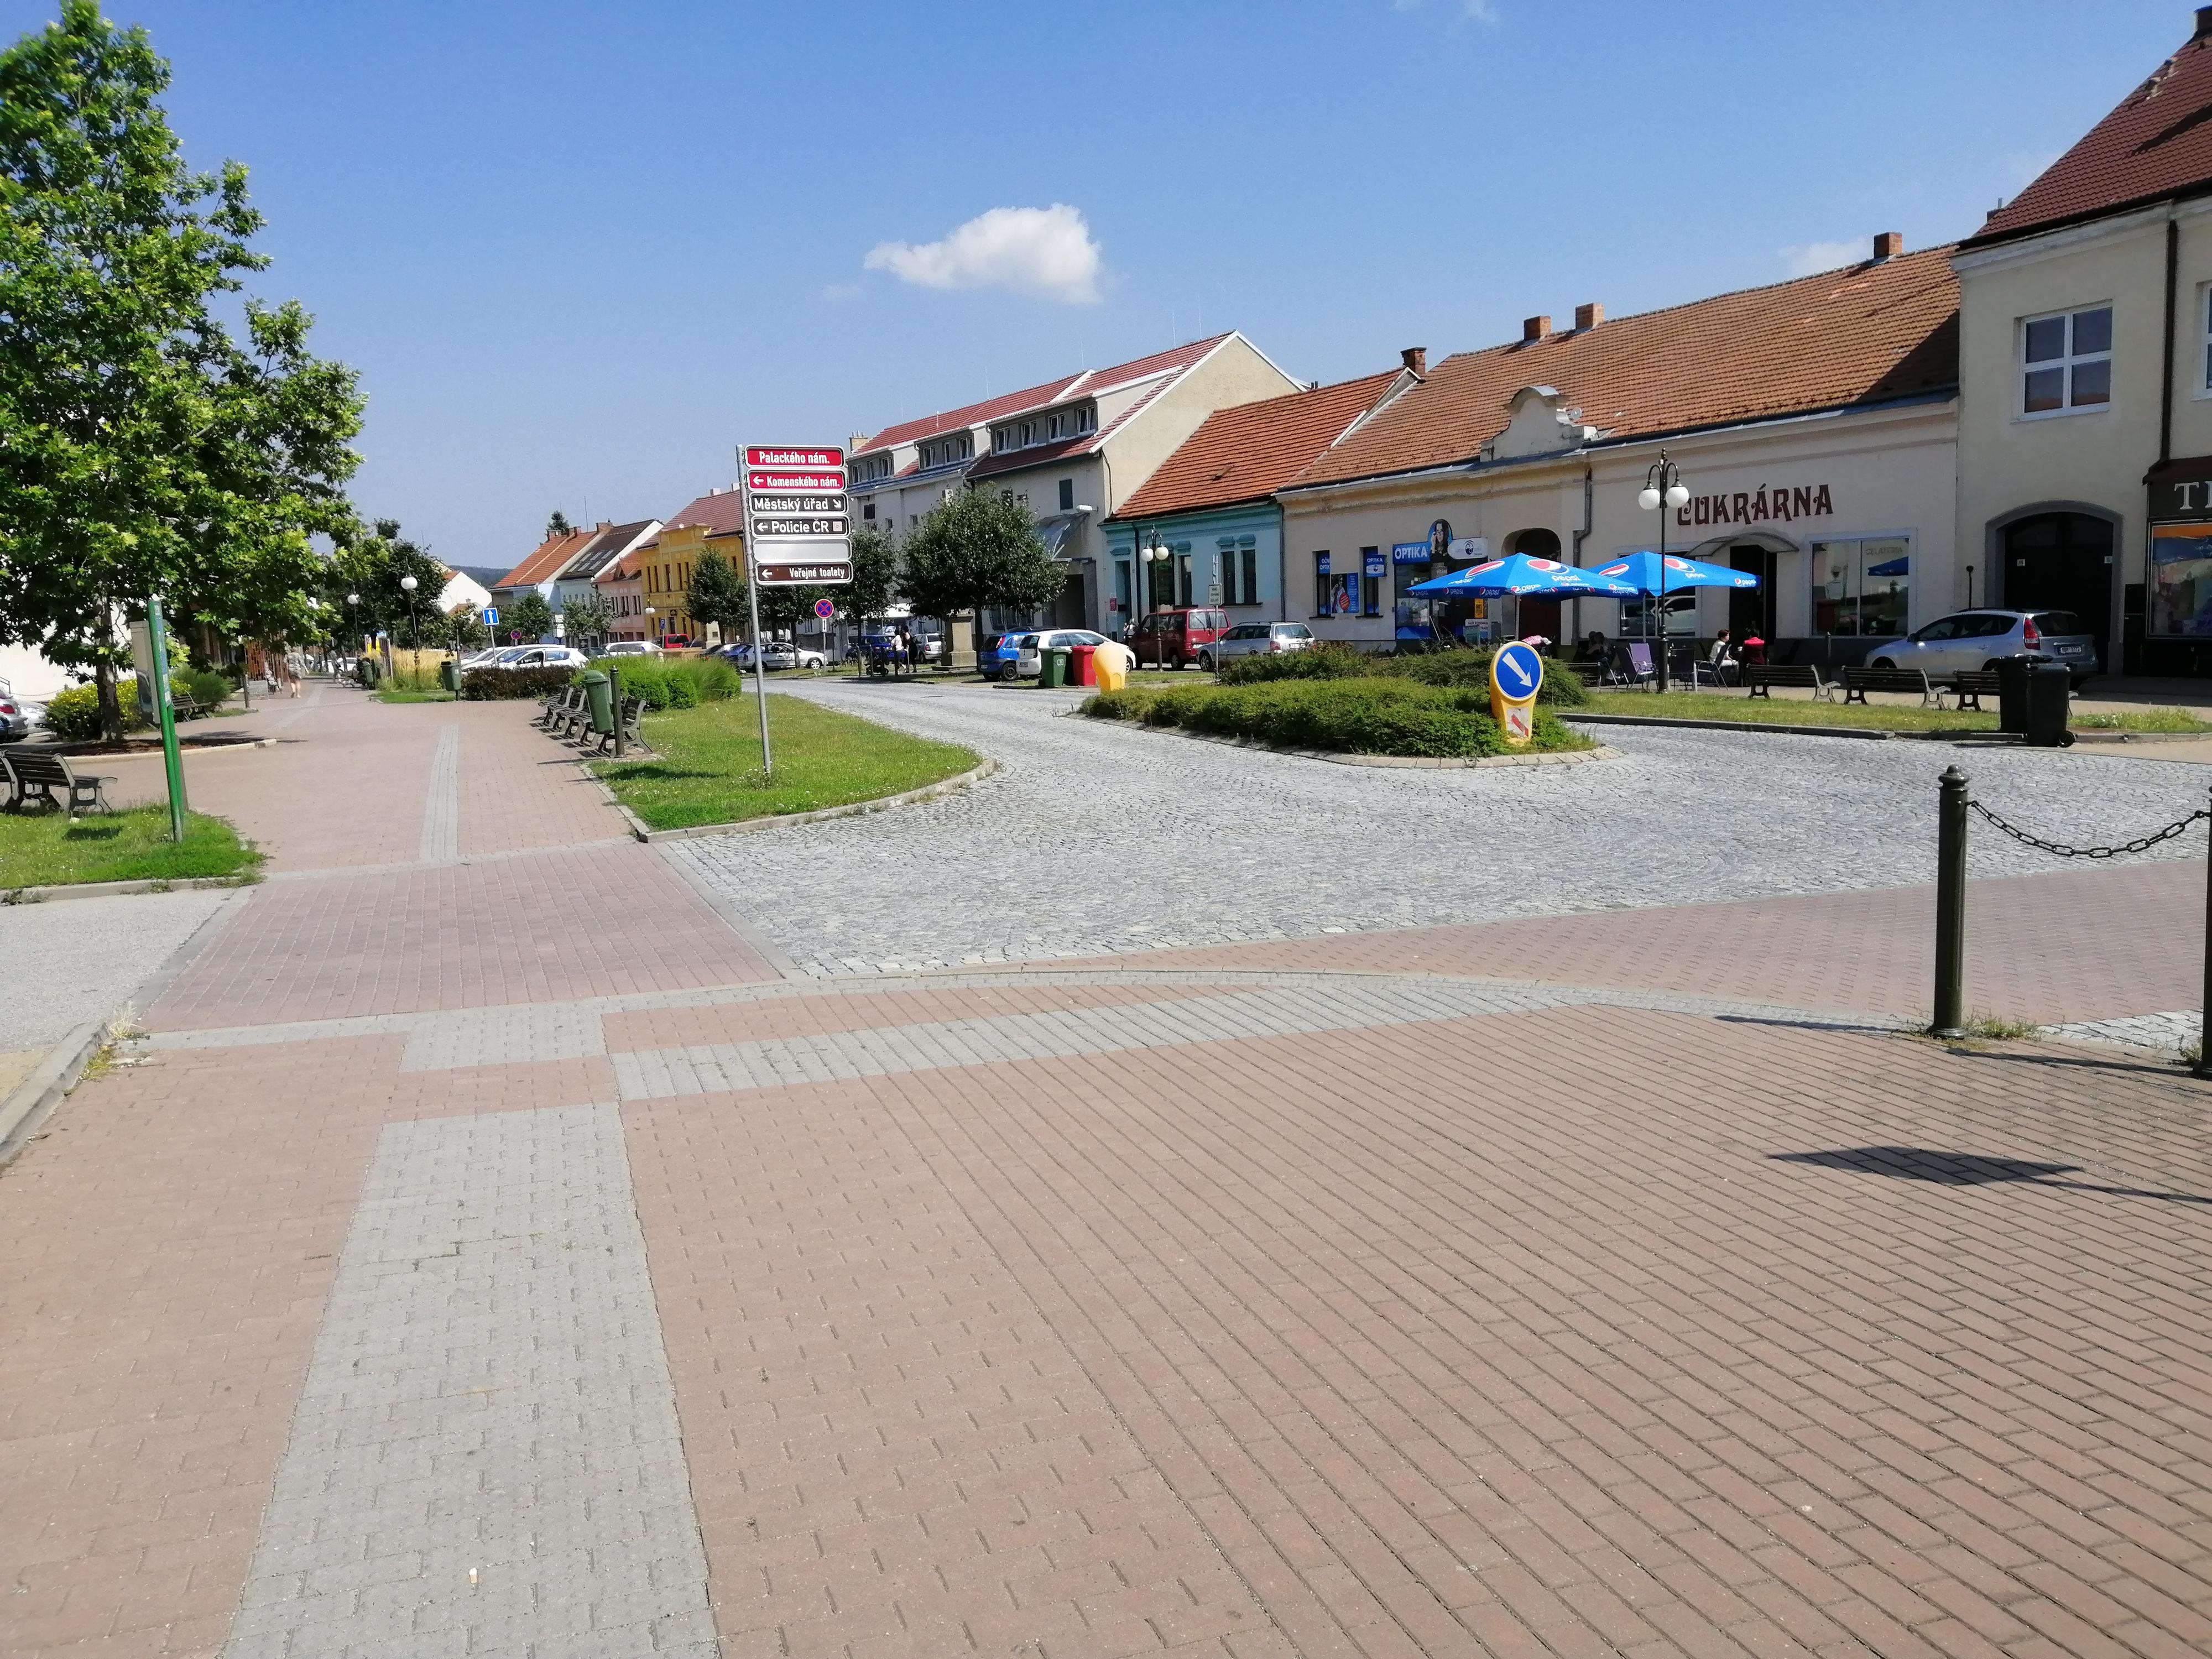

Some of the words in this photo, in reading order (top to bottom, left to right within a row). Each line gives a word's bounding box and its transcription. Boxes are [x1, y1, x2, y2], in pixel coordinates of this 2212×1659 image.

[759, 451, 806, 463] Palackého
[808, 451, 830, 463] nám.
[767, 476, 818, 487] Komenského
[820, 477, 840, 487] nám.
[754, 498, 800, 512] Městský
[804, 497, 828, 509] úřad
[1677, 483, 1834, 525] CUKRÁRNA
[771, 520, 810, 533] Policie
[812, 518, 830, 533] ČR
[1394, 546, 1428, 560] OPTIKA
[789, 567, 817, 580] Veřejné
[820, 568, 845, 578] toalety
